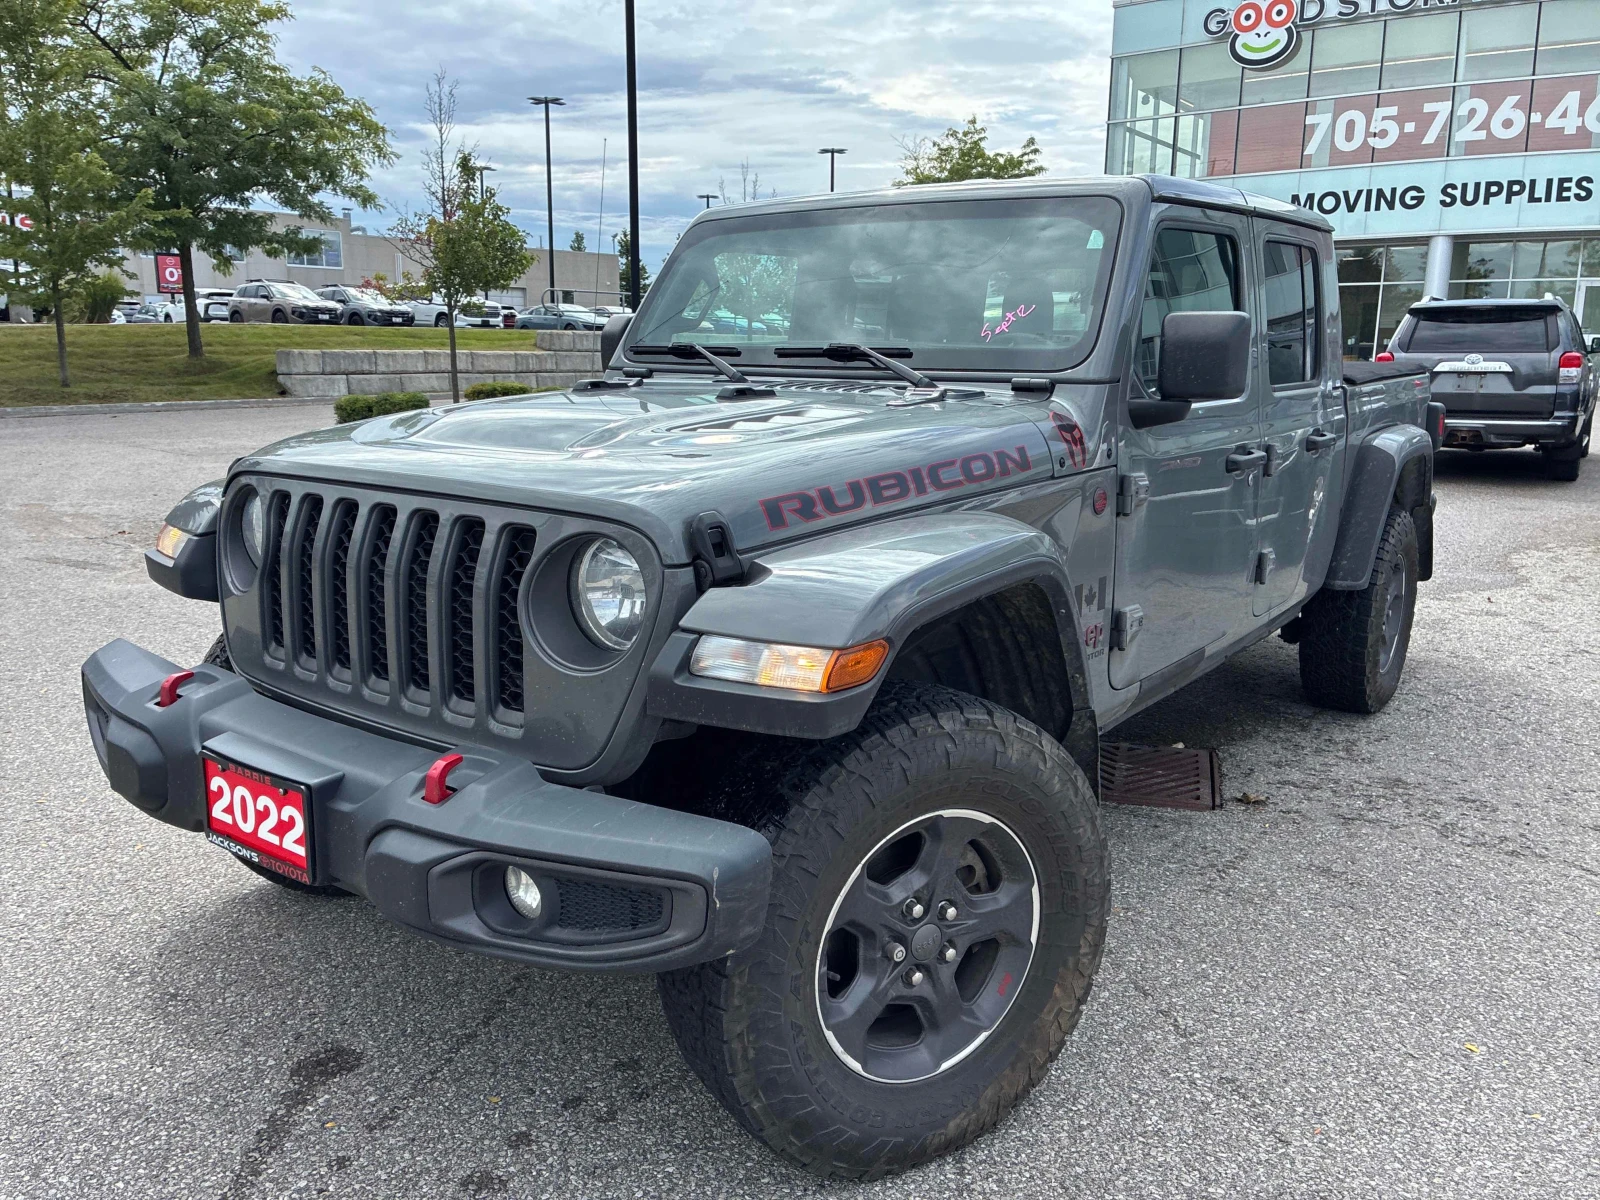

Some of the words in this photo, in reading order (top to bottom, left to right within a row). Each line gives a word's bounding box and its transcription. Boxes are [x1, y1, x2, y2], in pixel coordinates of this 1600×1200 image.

[1291, 185, 1426, 215] MOVING
[1439, 175, 1595, 208] SUPPLIES
[758, 445, 1032, 532] RUBICON
[228, 763, 272, 786] BARRIE
[210, 776, 305, 857] 2022
[207, 832, 259, 863] JACKSON'S
[269, 859, 310, 884] TOYOTA
